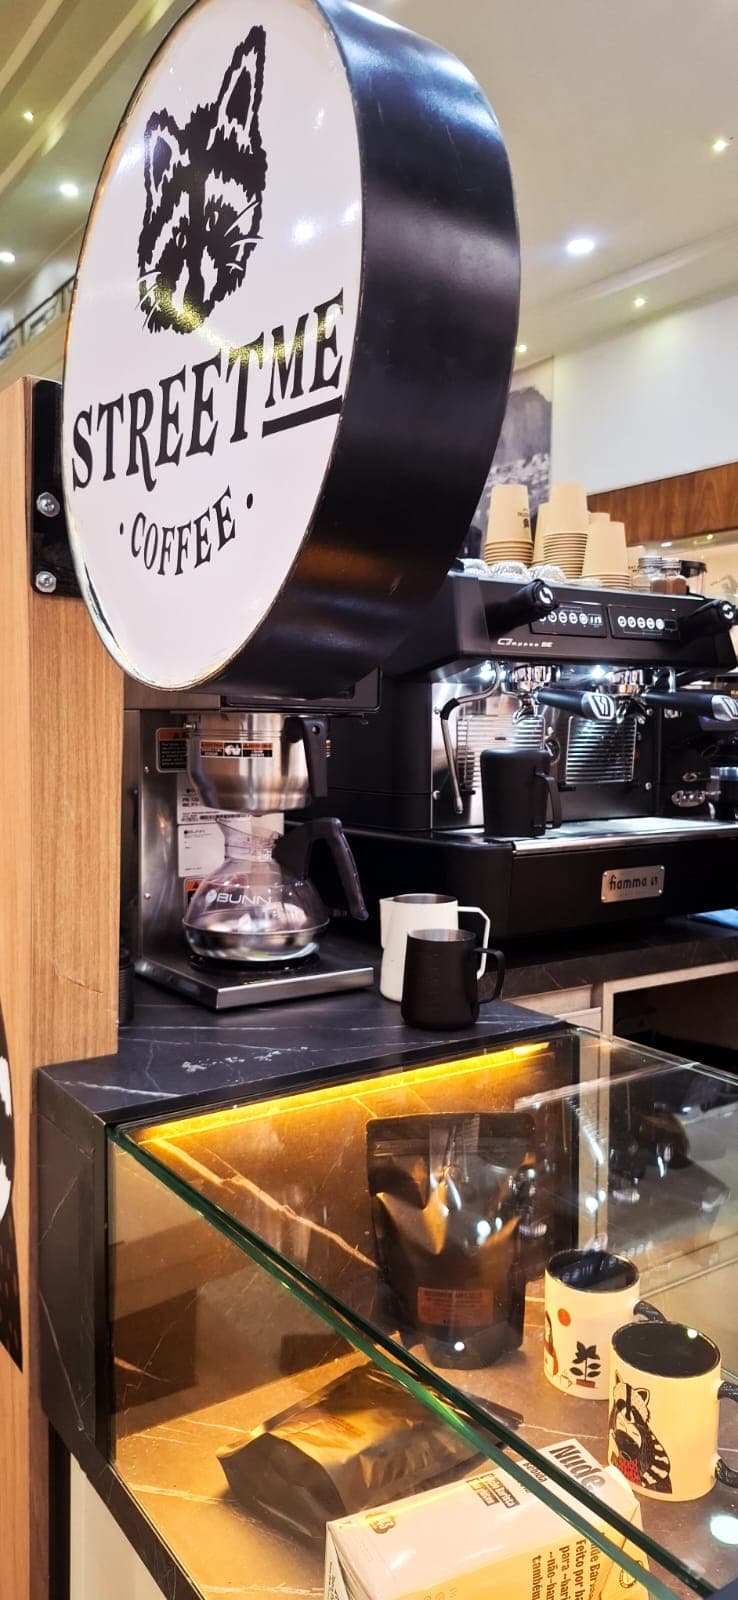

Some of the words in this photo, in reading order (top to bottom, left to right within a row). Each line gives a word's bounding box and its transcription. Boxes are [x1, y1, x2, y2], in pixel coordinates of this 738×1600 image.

[130, 484, 236, 576] COFFEE
[609, 874, 648, 891] fiamma
[216, 892, 272, 905] BUNN
[548, 1444, 606, 1491] Nude
[559, 1545, 570, 1572] para
[576, 1539, 587, 1568] Feito
[573, 1569, 584, 1588] por
